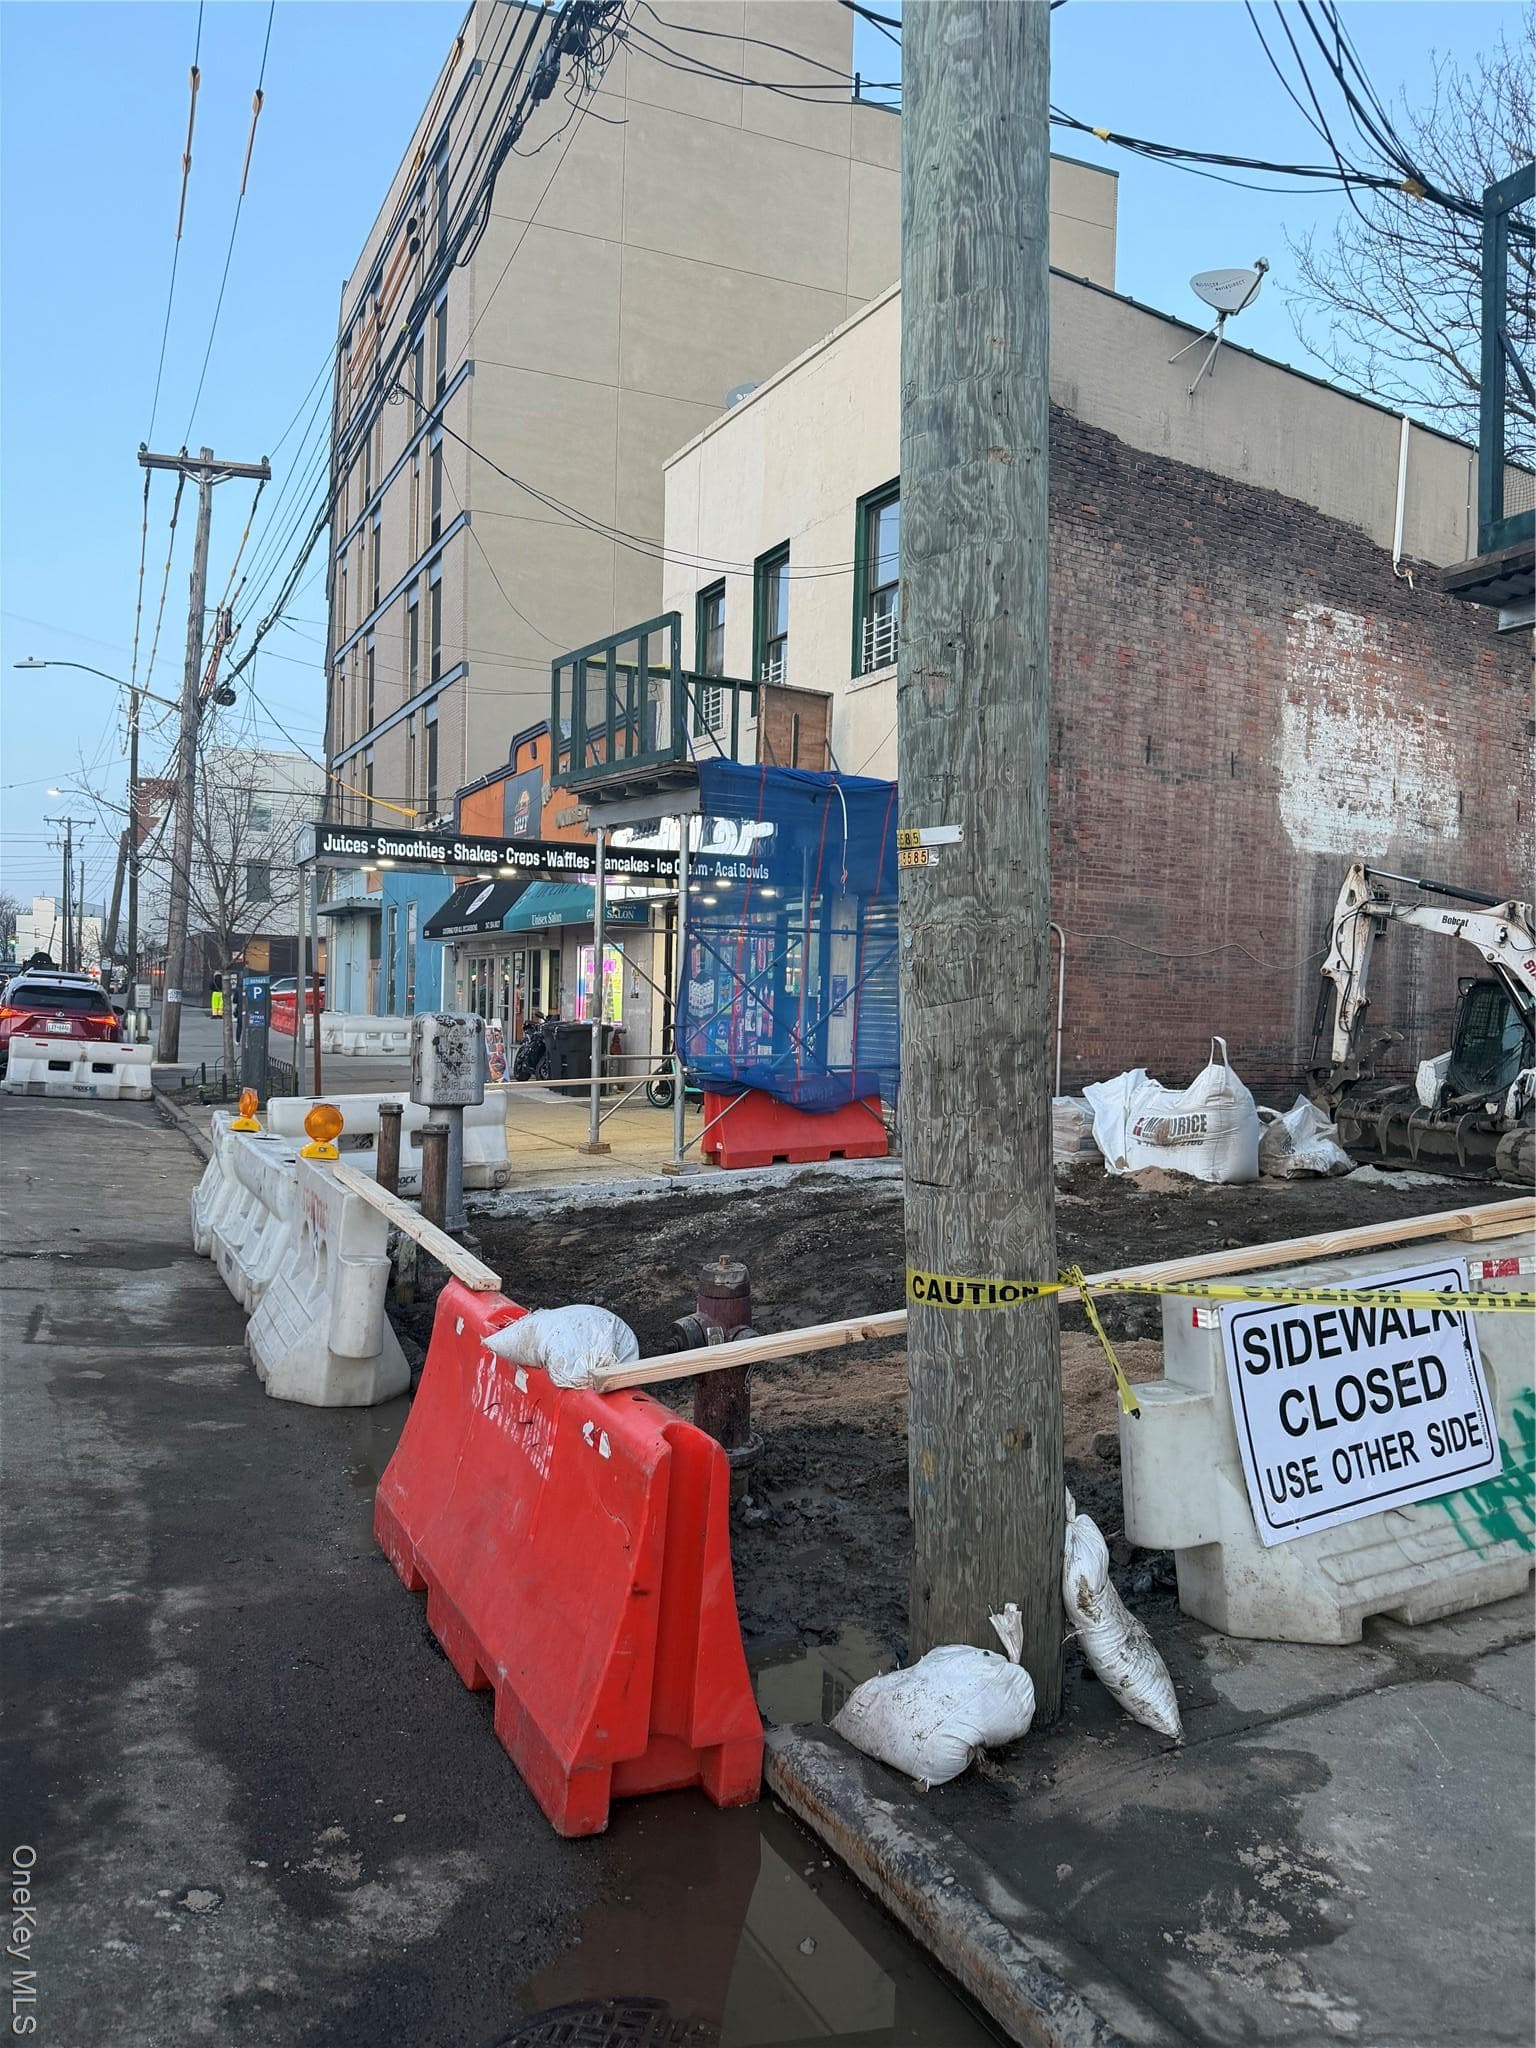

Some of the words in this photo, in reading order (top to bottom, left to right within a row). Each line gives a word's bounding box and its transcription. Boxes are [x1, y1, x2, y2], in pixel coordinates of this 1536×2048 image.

[323, 833, 368, 854] Juices
[377, 837, 446, 860] Smoothies
[454, 843, 498, 864] Shakes
[506, 847, 540, 867] Creps
[546, 850, 590, 869] Waffles
[603, 855, 650, 873] ancakes
[656, 857, 673, 874] Ice
[715, 861, 738, 878] Acai
[739, 863, 769, 879] Bowls
[1442, 915, 1469, 927] Bobcat
[912, 1275, 1039, 1305] CAUTION
[1242, 1285, 1459, 1375] SIDEWALK
[1279, 1355, 1447, 1438] CLOSED
[1266, 1456, 1323, 1504] USE
[1332, 1430, 1420, 1485] OTHER
[1427, 1412, 1483, 1457] SIDE
